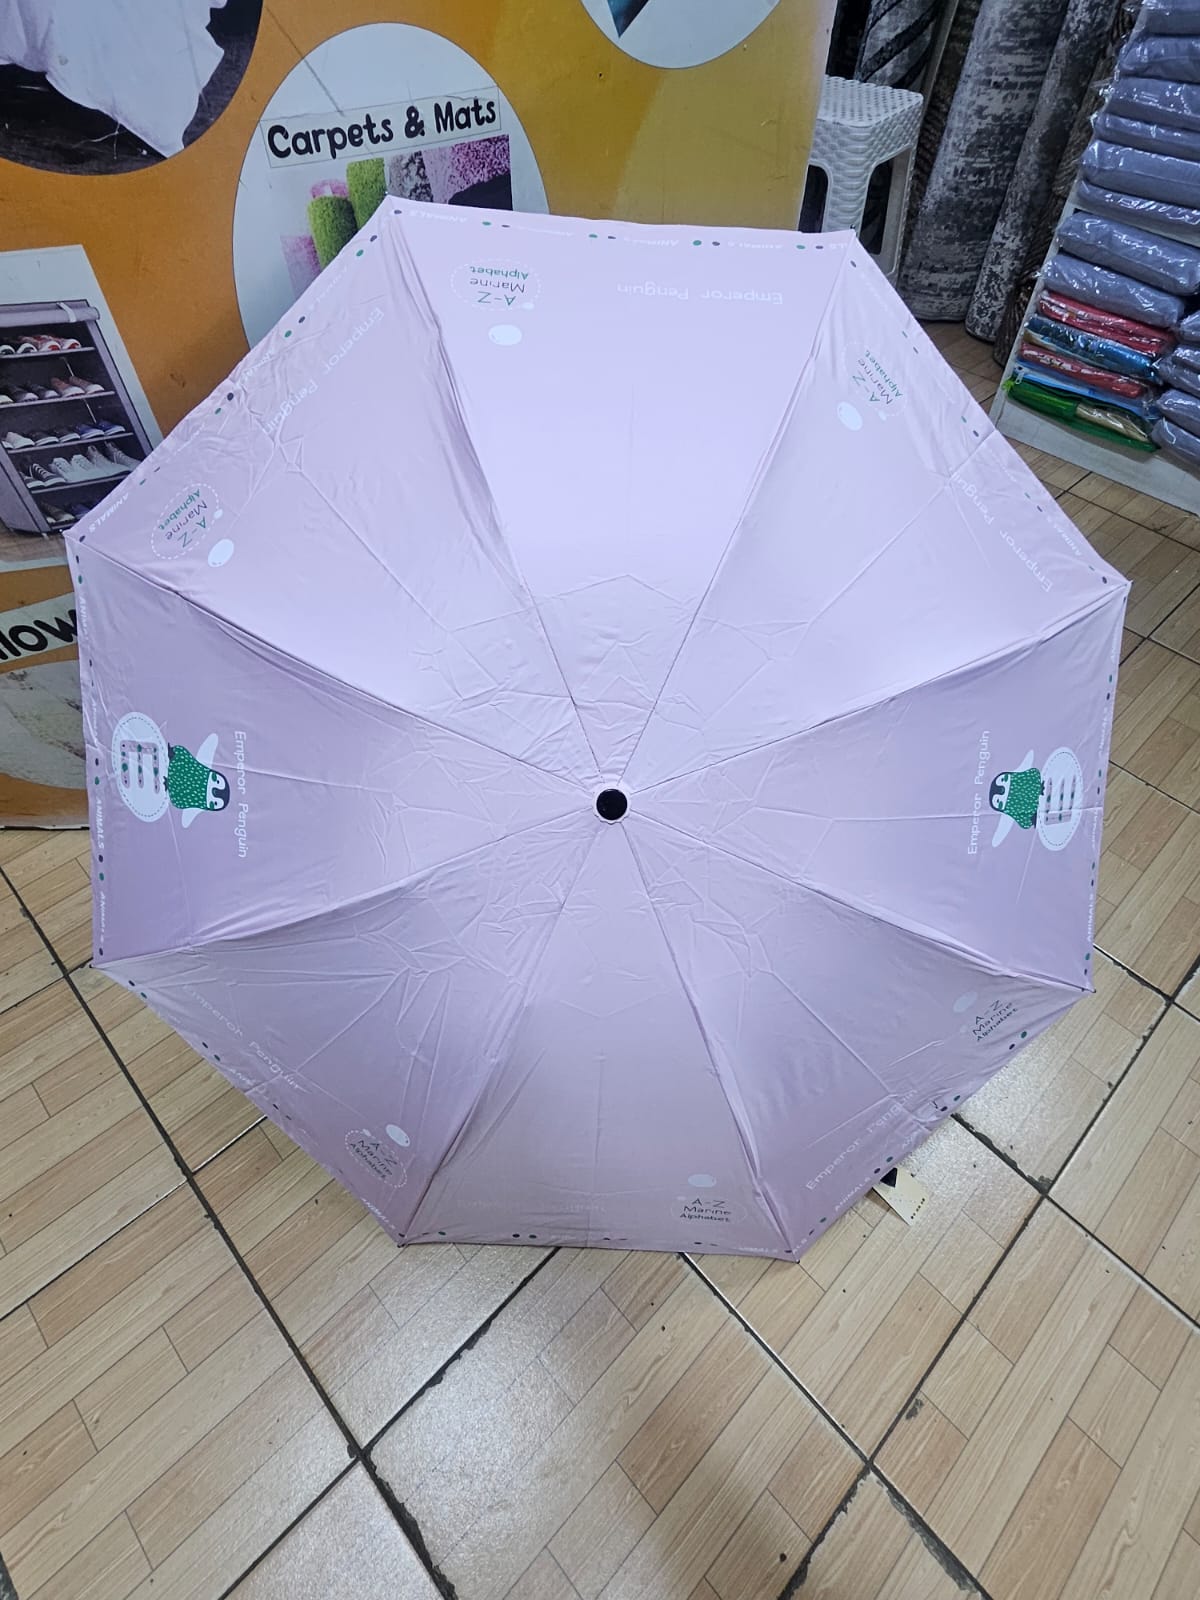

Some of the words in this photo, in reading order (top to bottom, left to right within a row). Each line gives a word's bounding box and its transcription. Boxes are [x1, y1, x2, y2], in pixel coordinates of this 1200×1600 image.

[266, 113, 394, 160] Carpets
[404, 105, 426, 138] &
[433, 97, 497, 134] Mats
[469, 265, 529, 281] Alphabet
[469, 278, 525, 294] Marine
[616, 280, 689, 300] Penguin
[701, 288, 783, 305] Emperor
[324, 306, 384, 376] Emperor
[857, 359, 894, 405] Marine
[88, 492, 130, 533] ANIMALS
[157, 488, 202, 531] Alphabet
[165, 500, 208, 541] Marine
[999, 529, 1054, 593] Emperor
[234, 730, 248, 796] Emperor
[974, 730, 991, 785] Penguin
[96, 799, 104, 850] ANIMALS
[234, 803, 249, 858] Penguin
[967, 793, 982, 855] Emperor
[805, 1138, 861, 1191] Emperor
[683, 1205, 732, 1215] Marine
